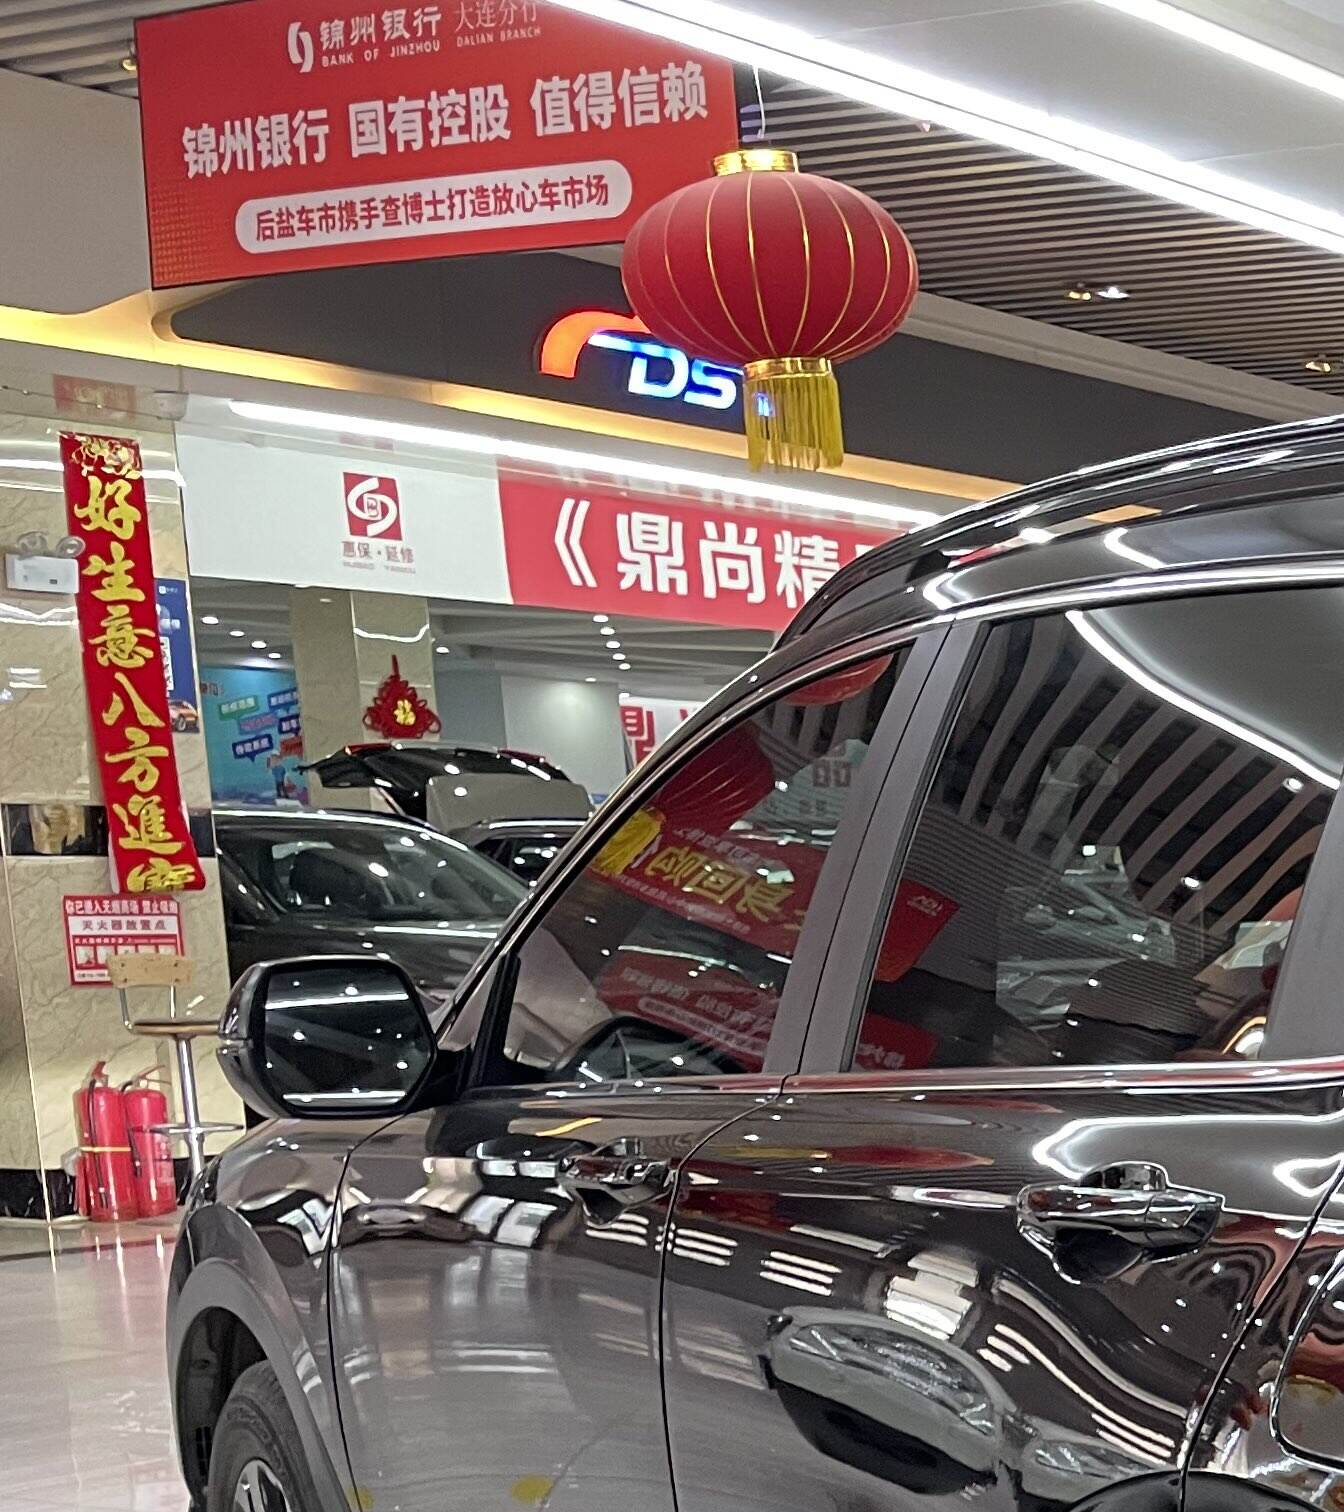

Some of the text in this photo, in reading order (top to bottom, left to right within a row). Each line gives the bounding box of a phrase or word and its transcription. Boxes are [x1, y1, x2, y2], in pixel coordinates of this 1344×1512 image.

[320, 0, 537, 50] 锦州银行 大连分行
[321, 27, 542, 67] BANK OF JINZHOU DALIAN BRANCH
[182, 61, 708, 179] 锦州银行 国有控股 值得信赖
[256, 175, 610, 241] 后盐车市携手查博士打造放心车市场
[554, 498, 876, 608] 《鼎尚精
